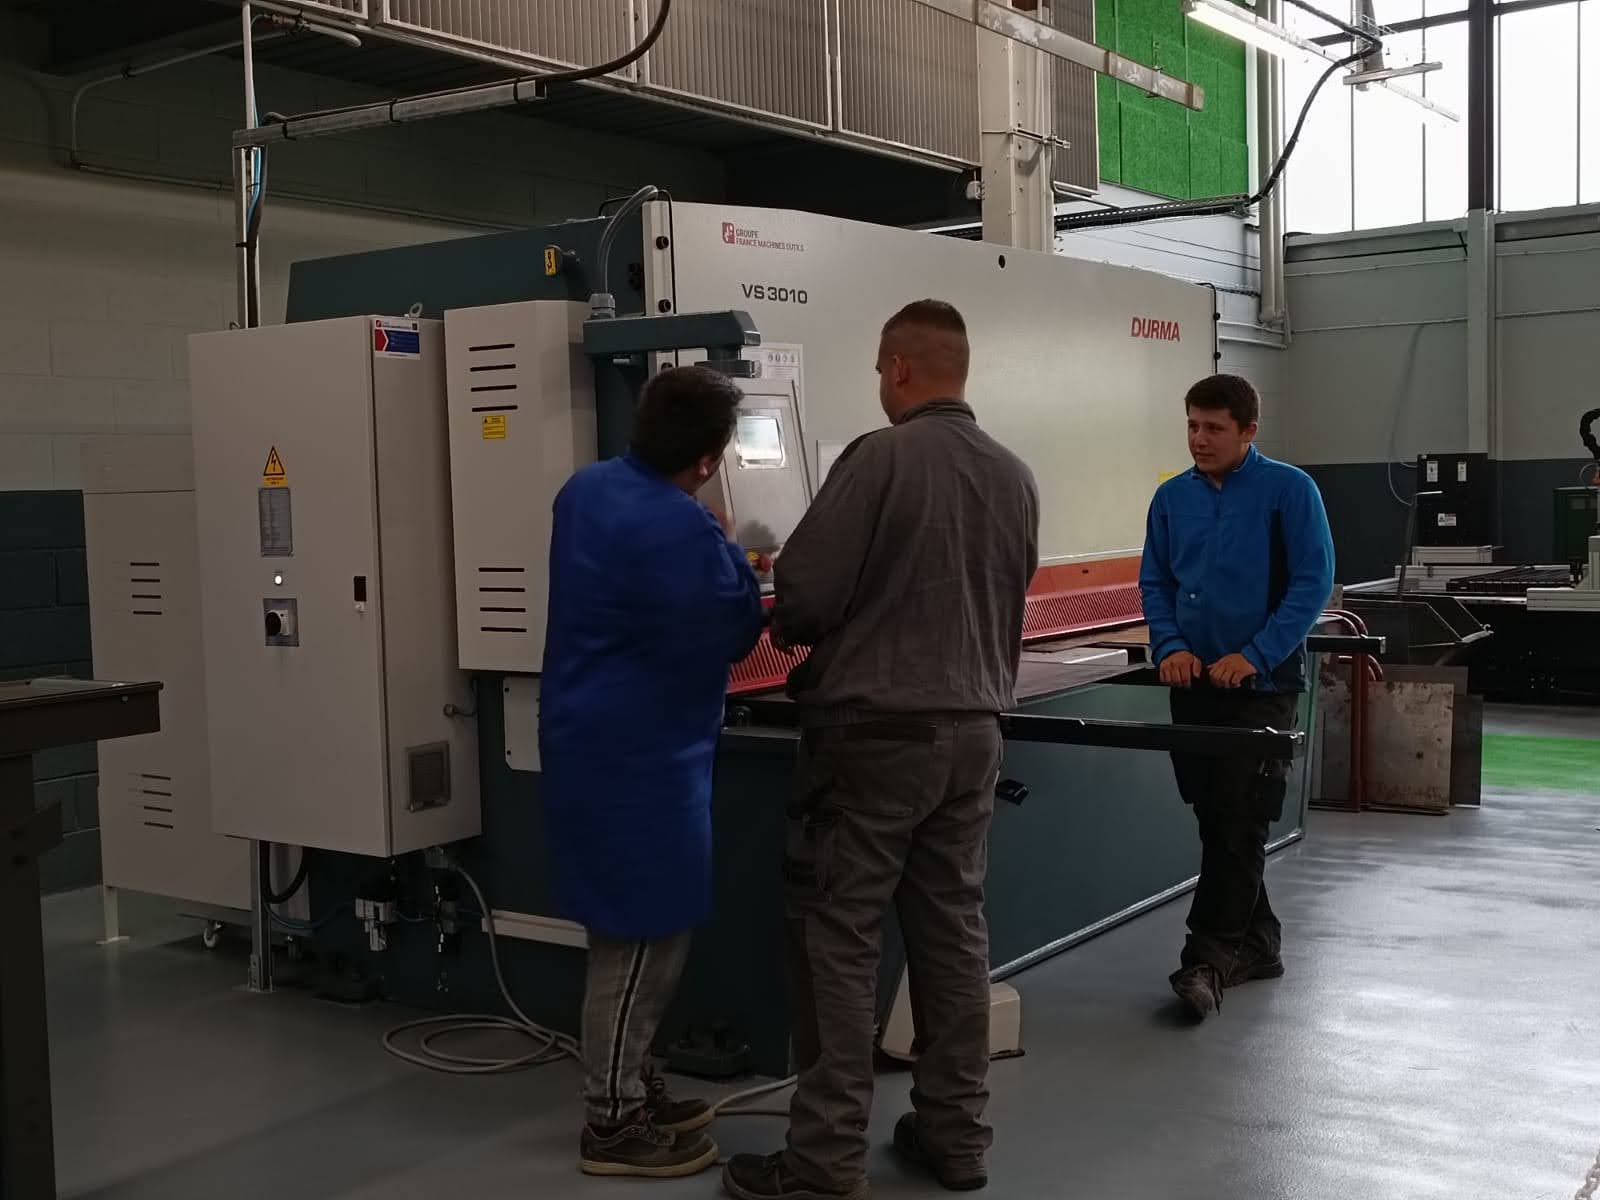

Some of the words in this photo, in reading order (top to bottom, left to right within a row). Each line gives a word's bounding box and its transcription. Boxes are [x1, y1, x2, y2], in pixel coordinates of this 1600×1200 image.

[736, 229, 758, 238] GROUPE
[736, 238, 757, 247] FRANCE
[758, 240, 785, 249] MACHINES
[786, 243, 804, 252] OUTILS
[741, 283, 765, 299] VS
[767, 286, 808, 304] 3010
[1131, 316, 1181, 342] DURMA
